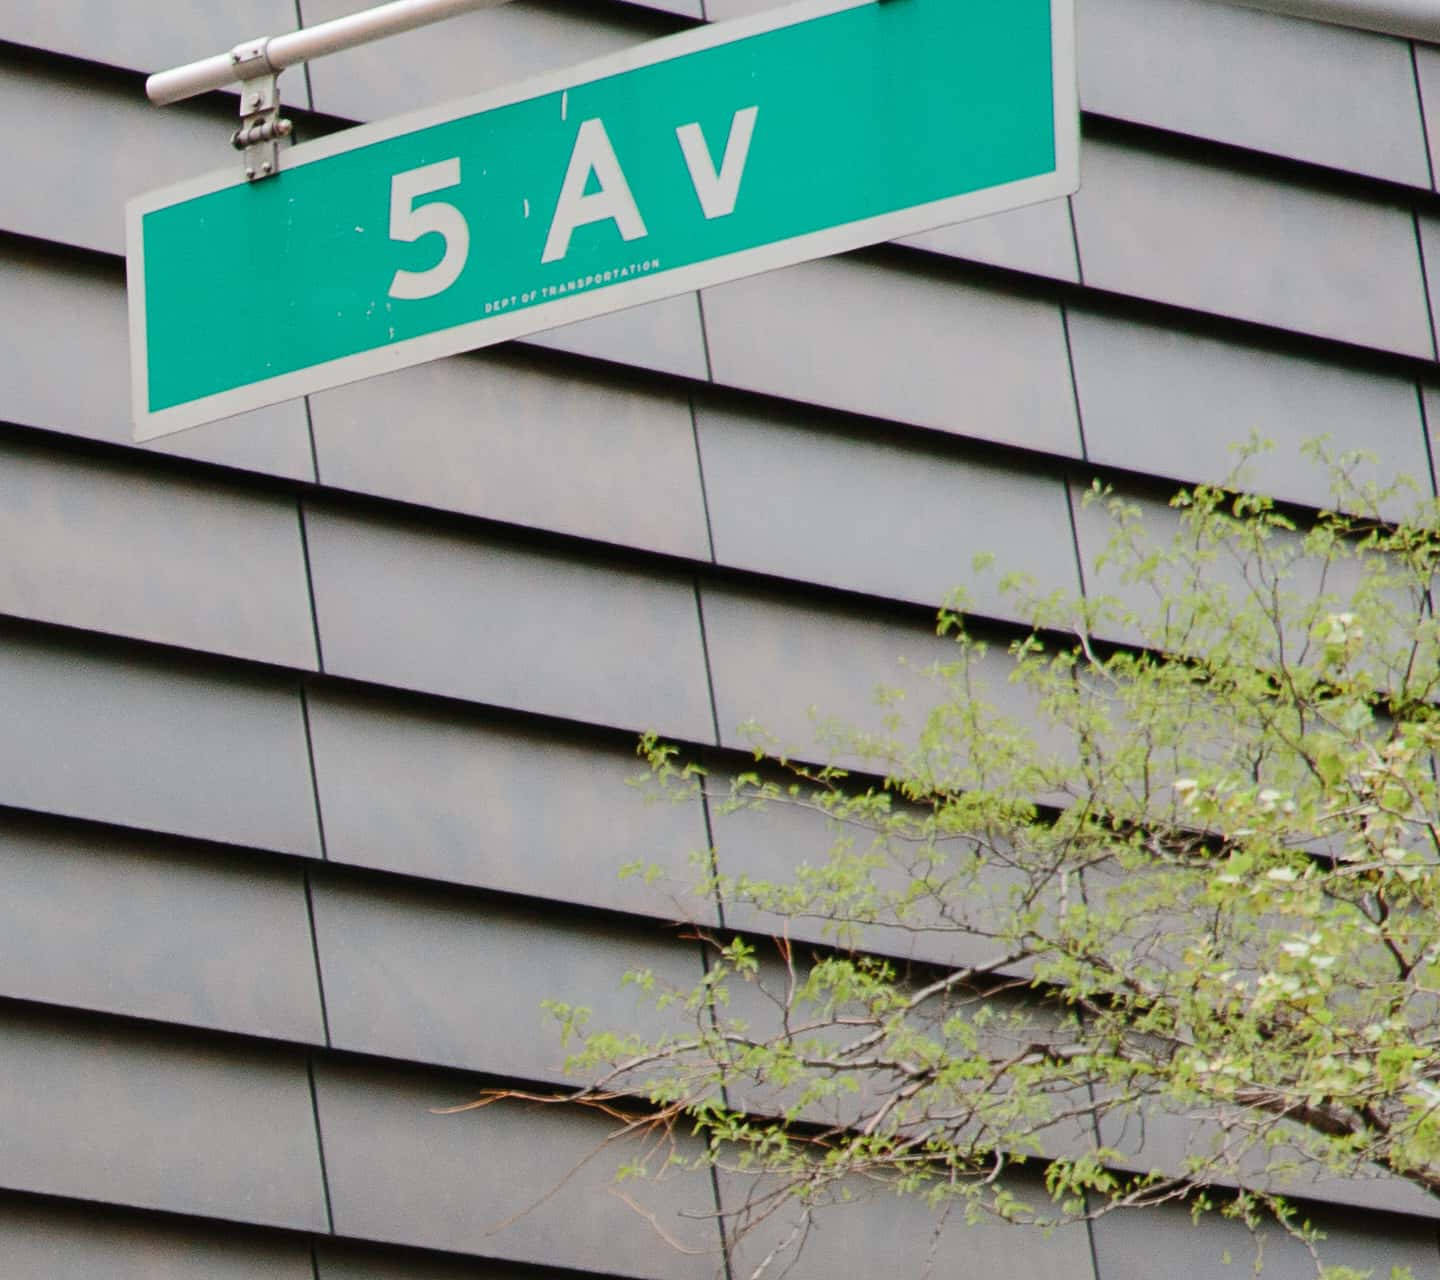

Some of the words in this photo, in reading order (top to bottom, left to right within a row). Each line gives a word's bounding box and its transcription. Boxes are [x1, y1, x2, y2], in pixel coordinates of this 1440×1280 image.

[387, 156, 470, 301] 5
[539, 105, 759, 265] Av
[485, 296, 517, 313] DEPT
[522, 290, 538, 303] OF
[542, 259, 660, 297] TRANSPORTATION
